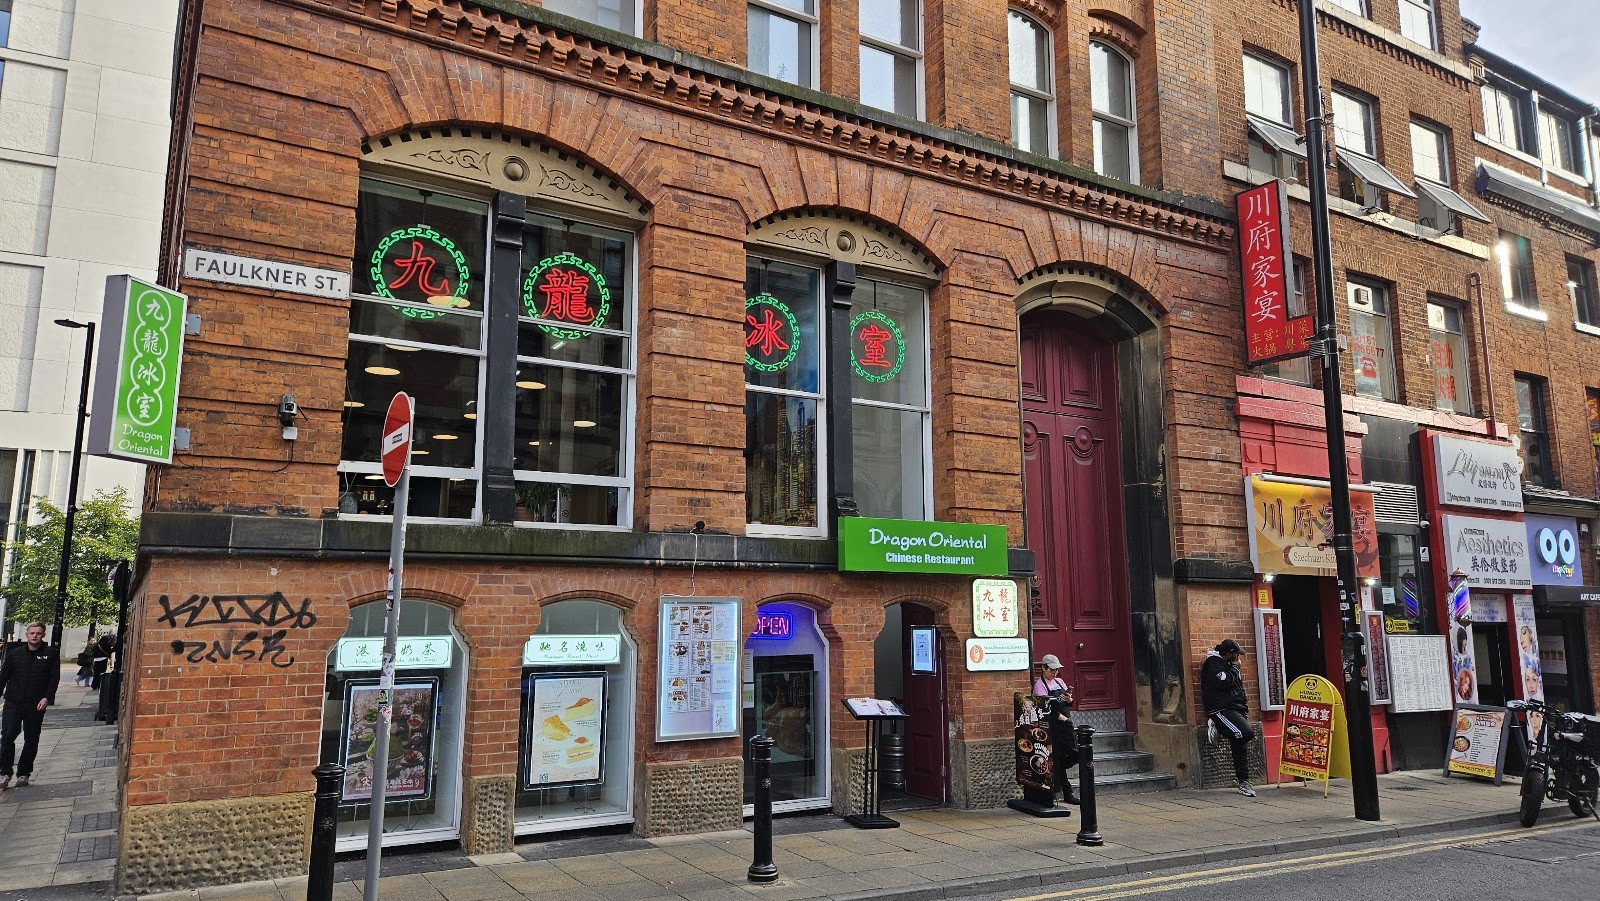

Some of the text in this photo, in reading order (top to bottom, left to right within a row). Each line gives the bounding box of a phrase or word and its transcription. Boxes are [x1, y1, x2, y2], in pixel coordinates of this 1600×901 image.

[1246, 187, 1281, 323] 川府家宴
[195, 256, 342, 292] FAULKNER ST.
[389, 241, 892, 368] 九 龍 冰 室
[136, 298, 164, 419] 九龍冰室
[121, 423, 163, 443] Dragon
[118, 439, 163, 457] Oriental
[869, 528, 987, 551] Dragon Oriental
[1457, 529, 1524, 557] Aesthetics
[885, 552, 975, 565] Chinese Restaurant
[1580, 593, 1590, 601] ART
[752, 616, 789, 635] OPEN
[356, 642, 436, 656] 港奶茶
[1288, 704, 1330, 721] 川府家宴
